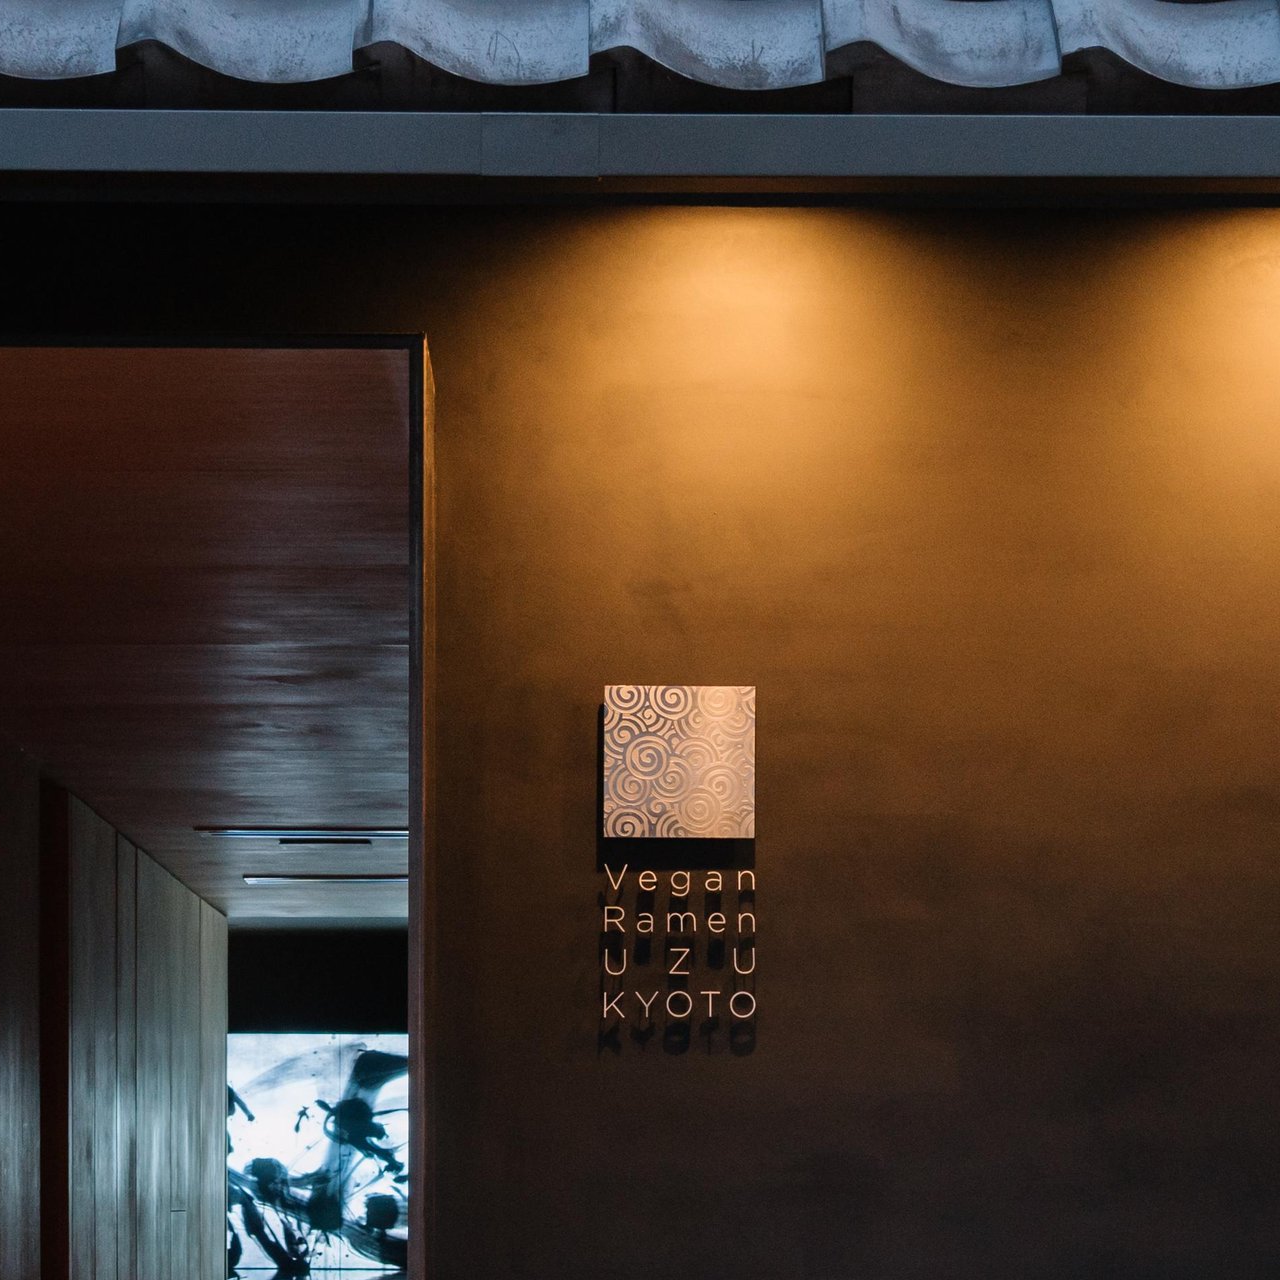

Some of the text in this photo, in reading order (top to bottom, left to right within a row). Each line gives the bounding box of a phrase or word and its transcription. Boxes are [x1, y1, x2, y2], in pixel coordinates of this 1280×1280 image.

[603, 863, 756, 897] Vegan
[603, 906, 757, 933] Ramen
[603, 990, 757, 1019] KYOTO
